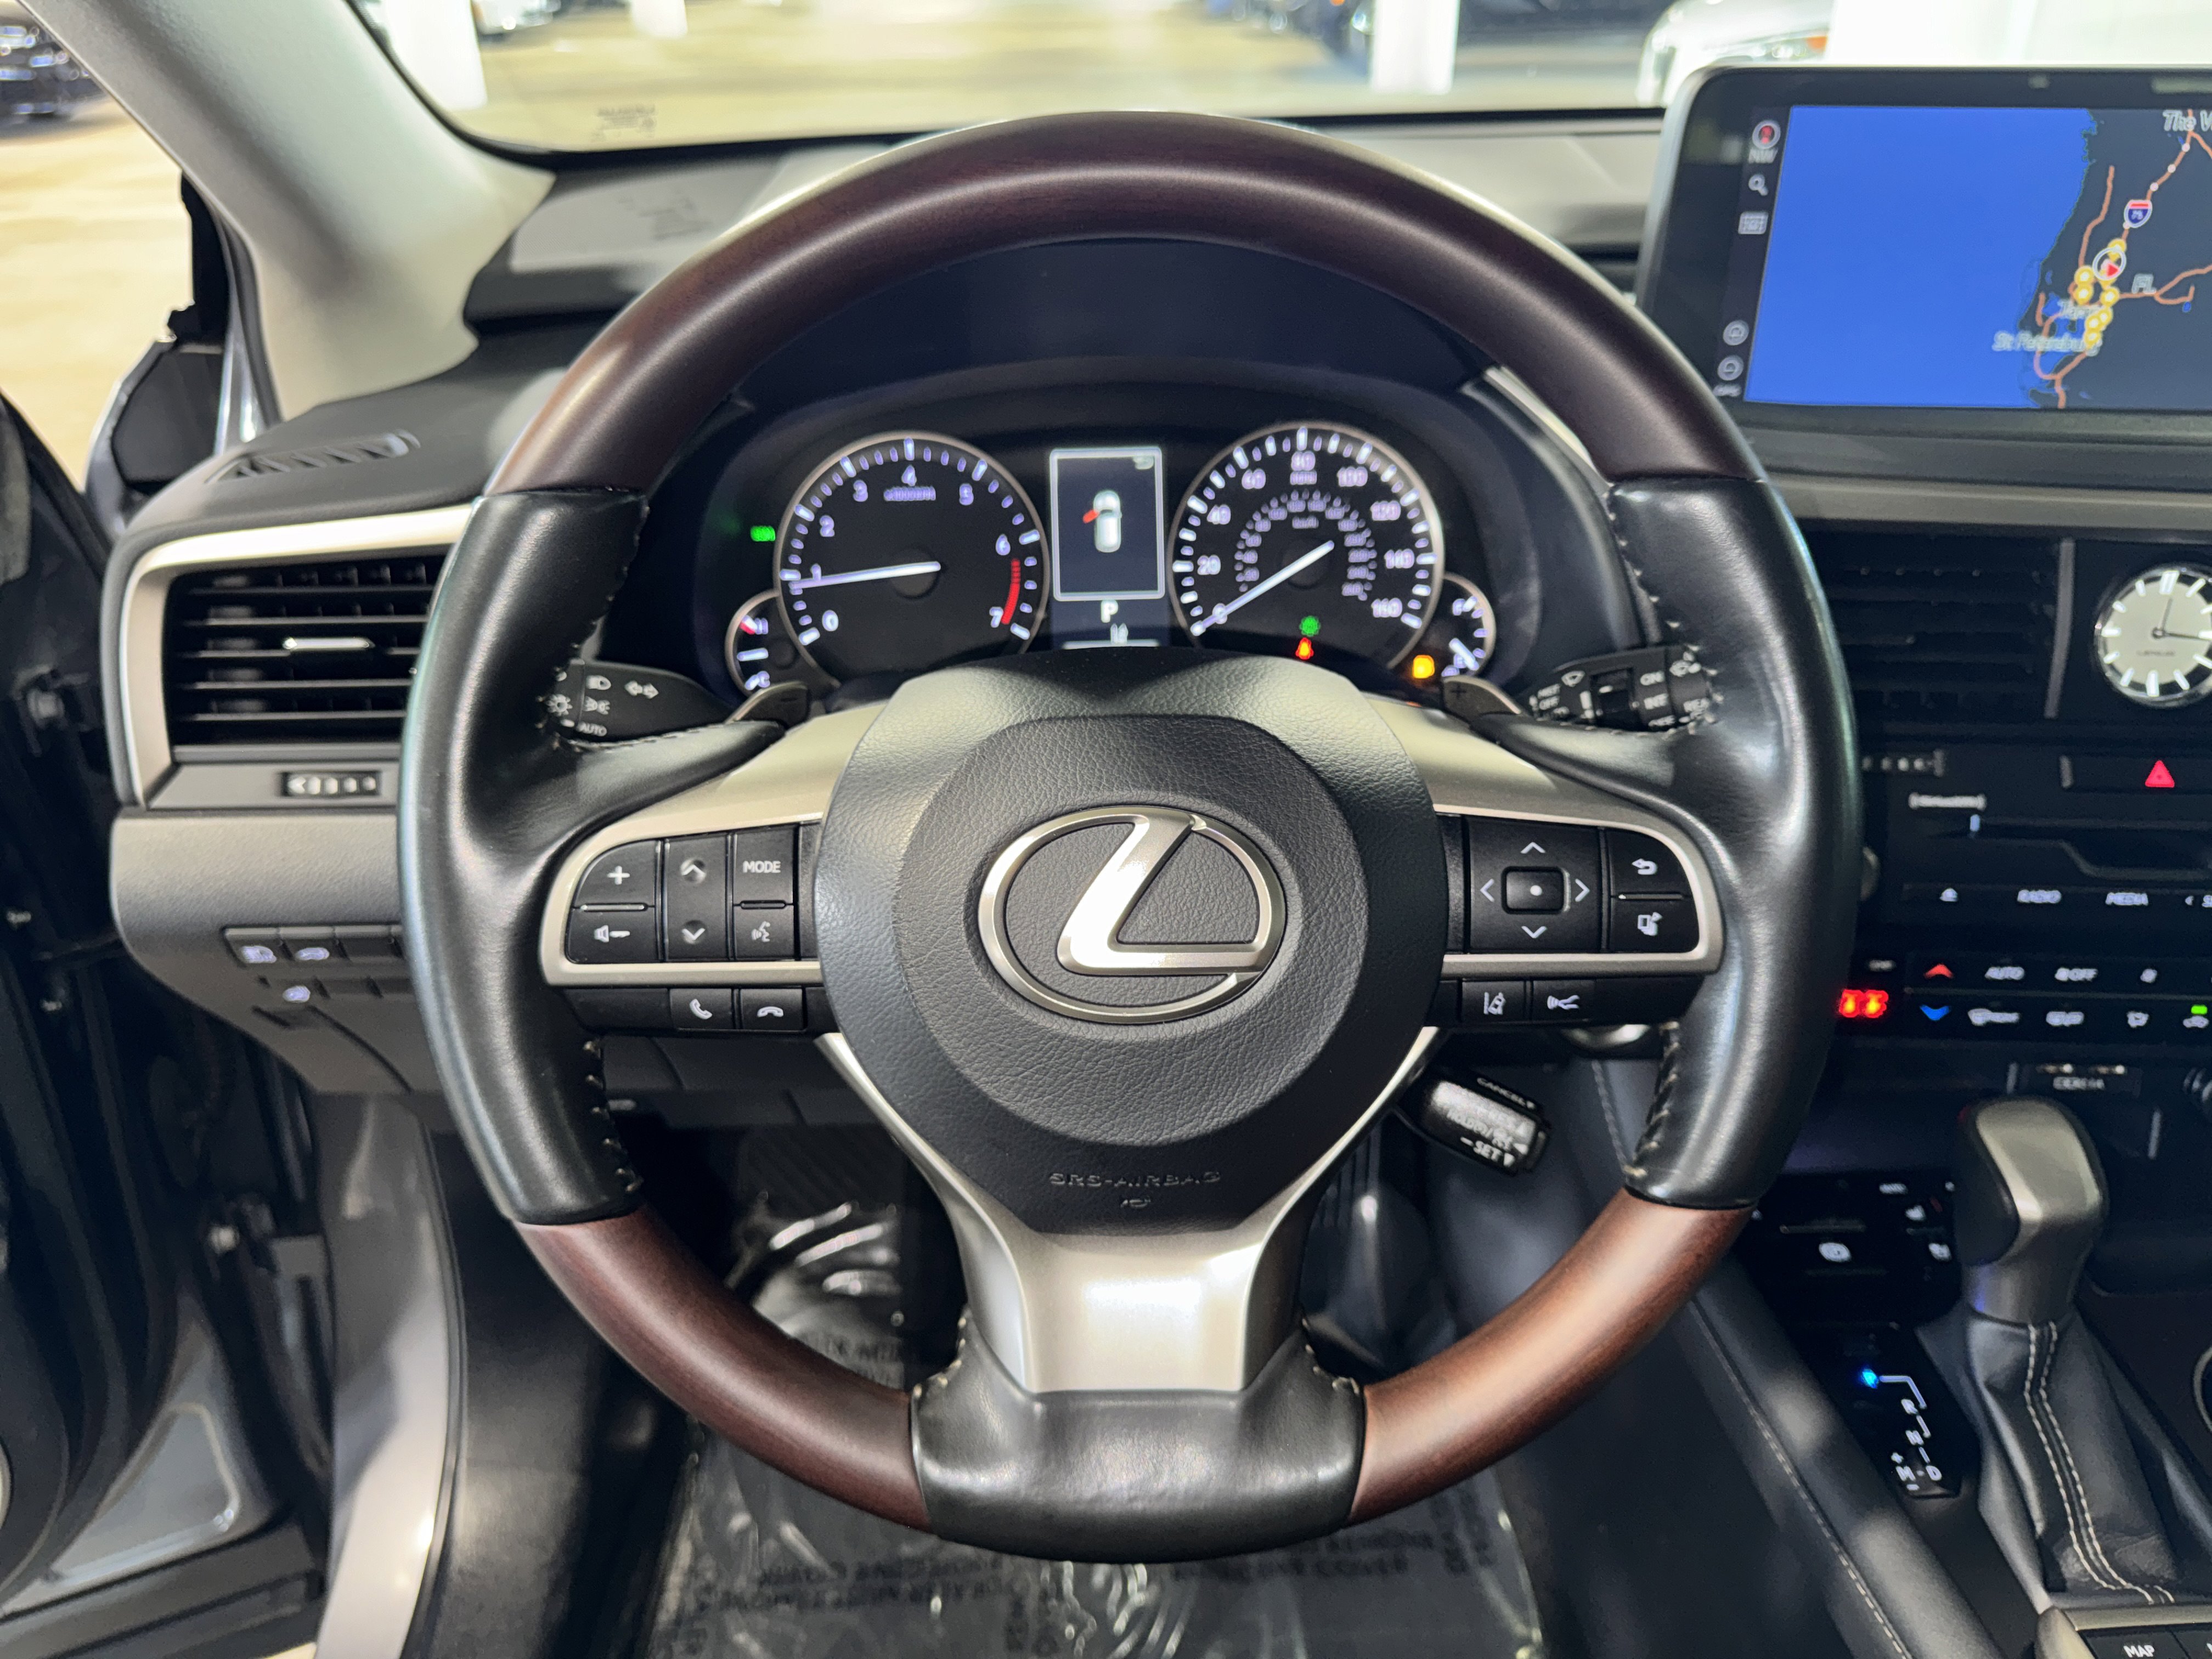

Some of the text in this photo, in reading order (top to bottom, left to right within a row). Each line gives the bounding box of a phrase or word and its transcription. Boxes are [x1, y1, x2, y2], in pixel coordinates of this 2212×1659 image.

[820, 515, 834, 537] 2
[1197, 555, 1221, 575] 20
[822, 610, 839, 631] 0
[1101, 599, 1119, 623] P
[743, 860, 781, 874] MODE
[1925, 1465, 1943, 1481] D
[2123, 1644, 2155, 1658] MAP
